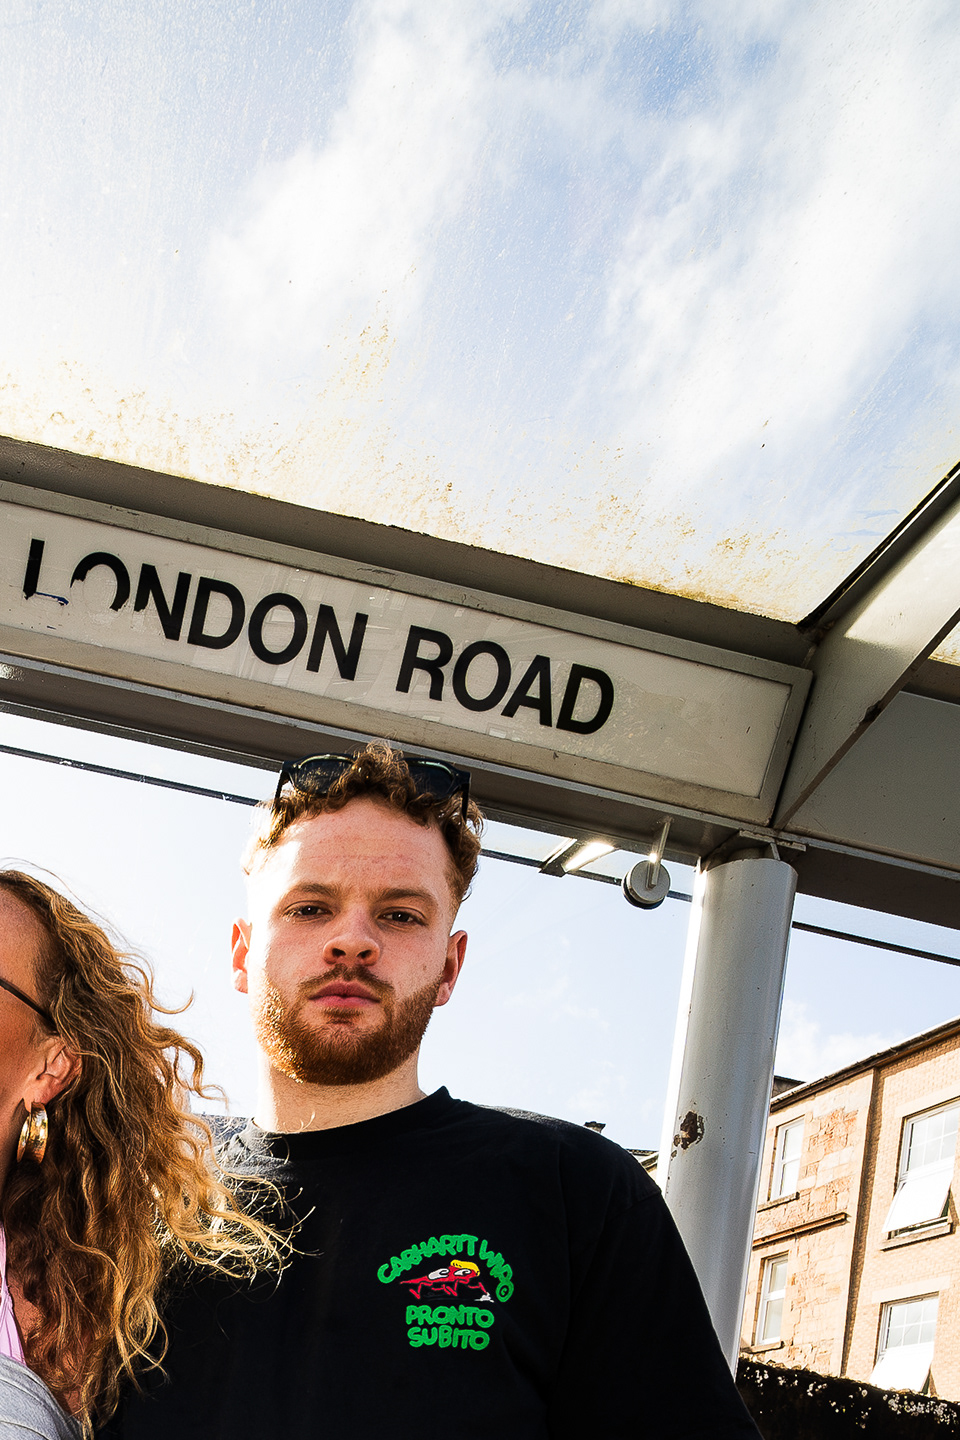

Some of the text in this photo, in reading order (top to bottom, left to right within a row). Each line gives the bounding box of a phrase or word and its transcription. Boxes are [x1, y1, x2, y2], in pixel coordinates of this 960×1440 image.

[396, 625, 614, 735] ROAD
[377, 1234, 478, 1283] CARHARTT
[406, 1304, 494, 1328] PRONTO
[407, 1325, 490, 1350] SUBITO
